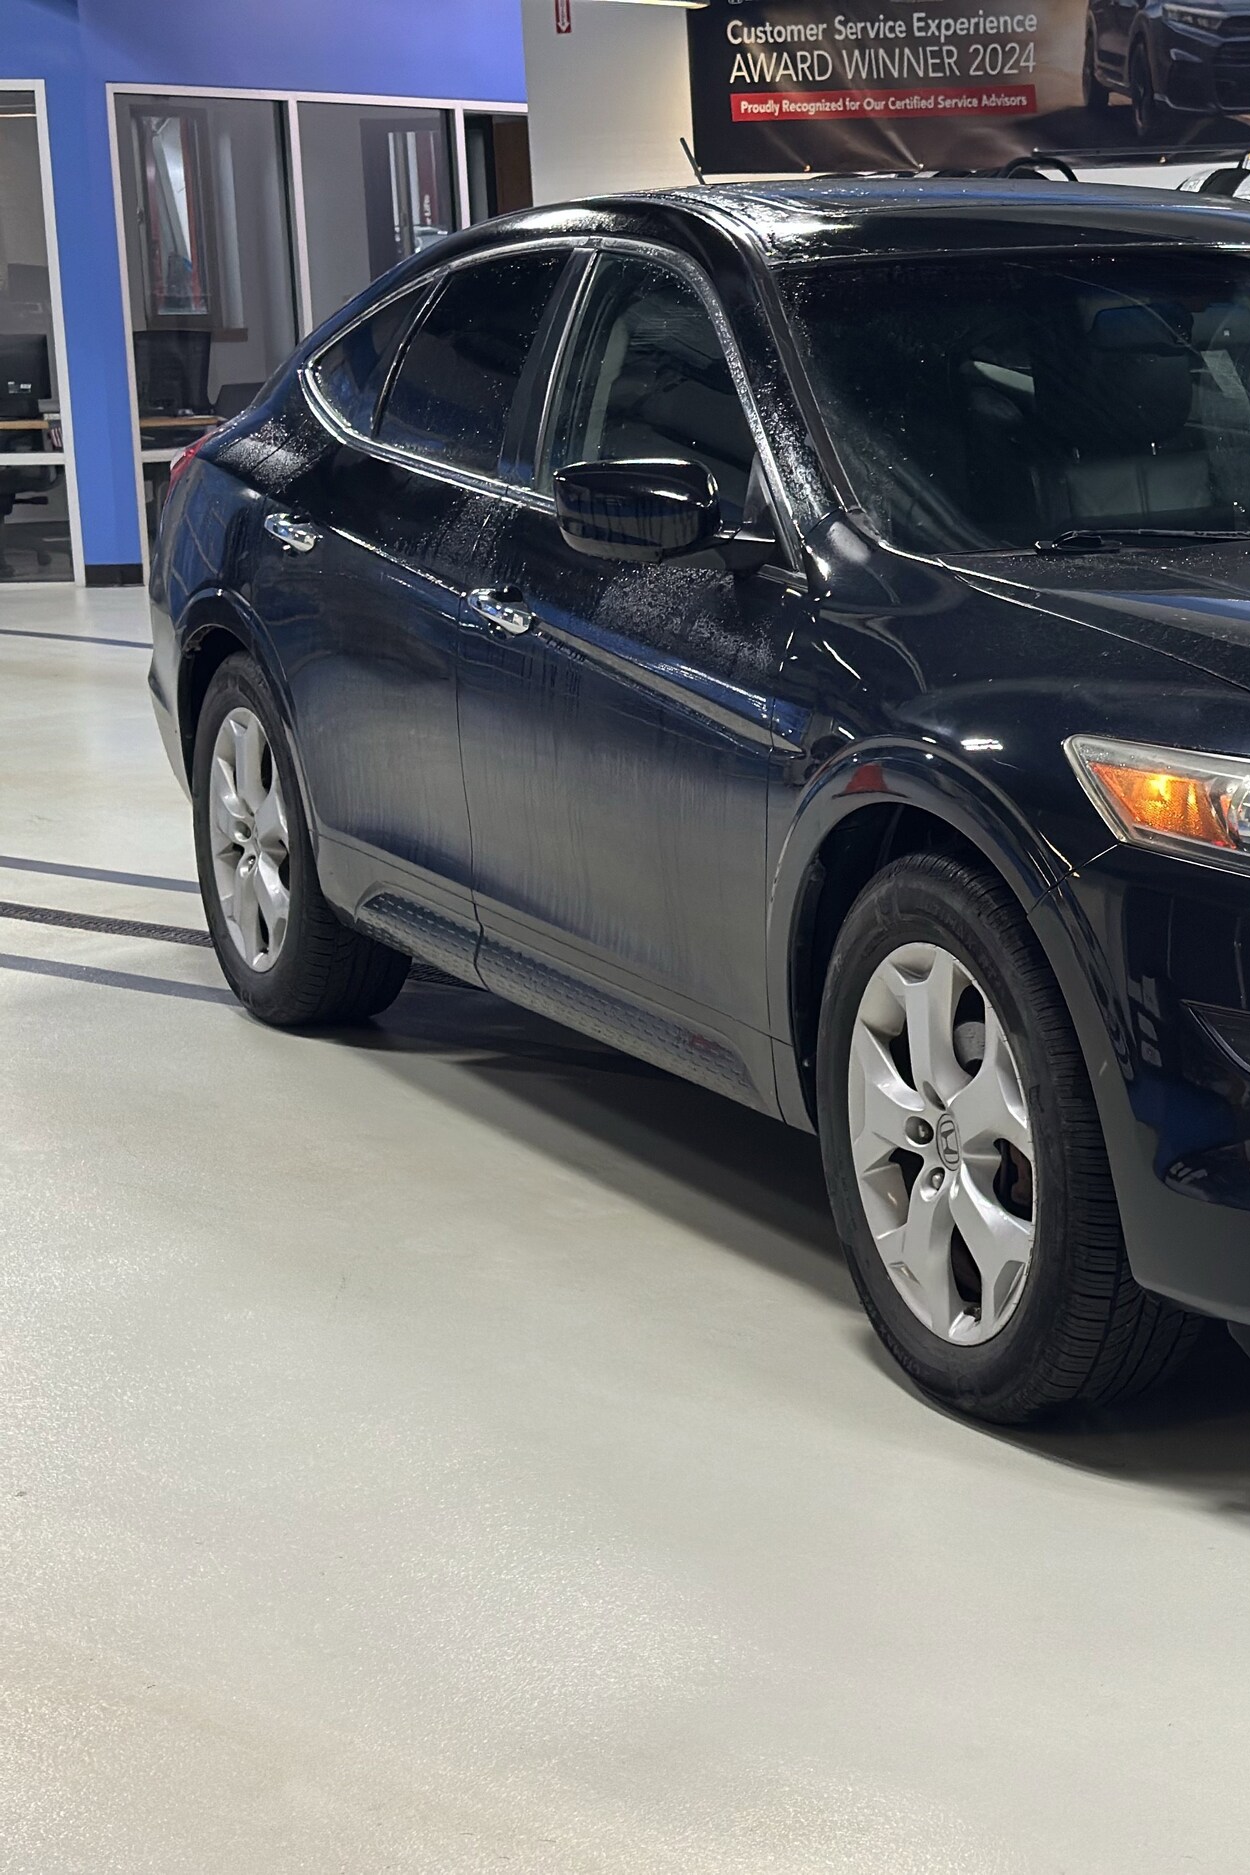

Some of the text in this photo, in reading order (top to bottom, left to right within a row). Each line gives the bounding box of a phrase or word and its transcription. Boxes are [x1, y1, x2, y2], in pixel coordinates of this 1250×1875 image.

[726, 9, 1038, 45] Customer Service Experience
[729, 42, 1037, 84] AWARD WINNER 2024
[740, 93, 1027, 116] Proudly Recognized for Our Certified Service Advisors
